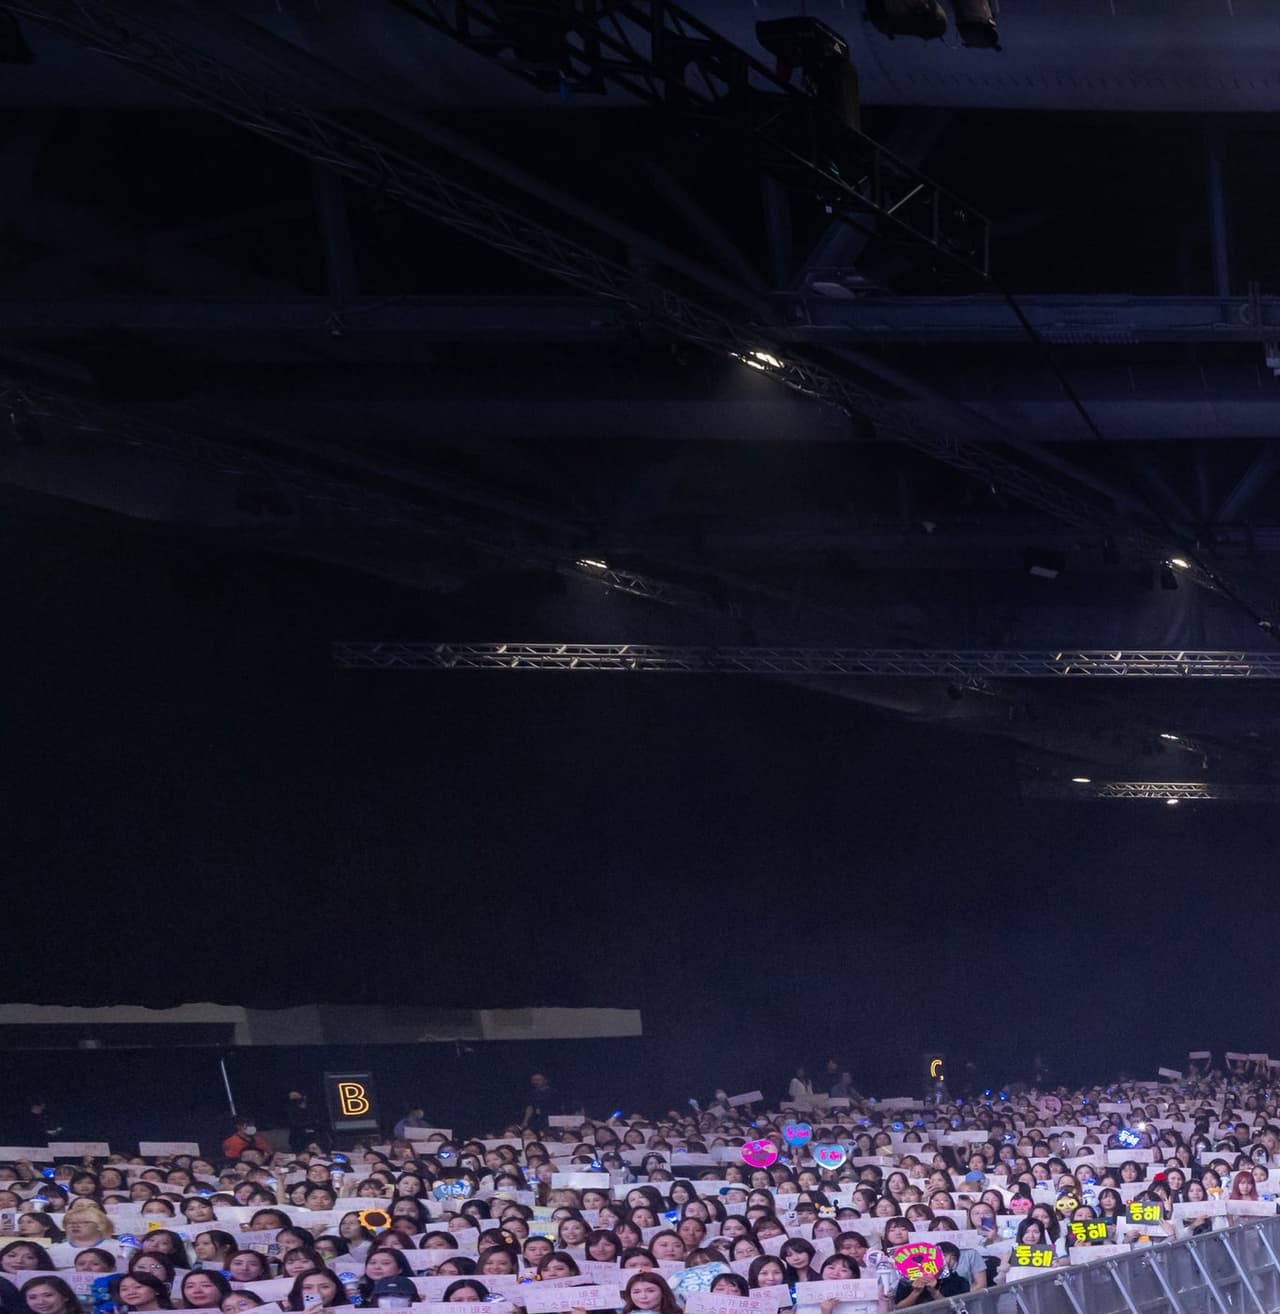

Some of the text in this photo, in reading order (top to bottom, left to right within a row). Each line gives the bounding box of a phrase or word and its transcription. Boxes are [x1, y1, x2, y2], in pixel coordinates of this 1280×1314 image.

[338, 1082, 370, 1117] B
[1129, 1201, 1160, 1222] 동해
[1071, 1222, 1107, 1242] 동해
[1015, 1245, 1053, 1267] 동해
